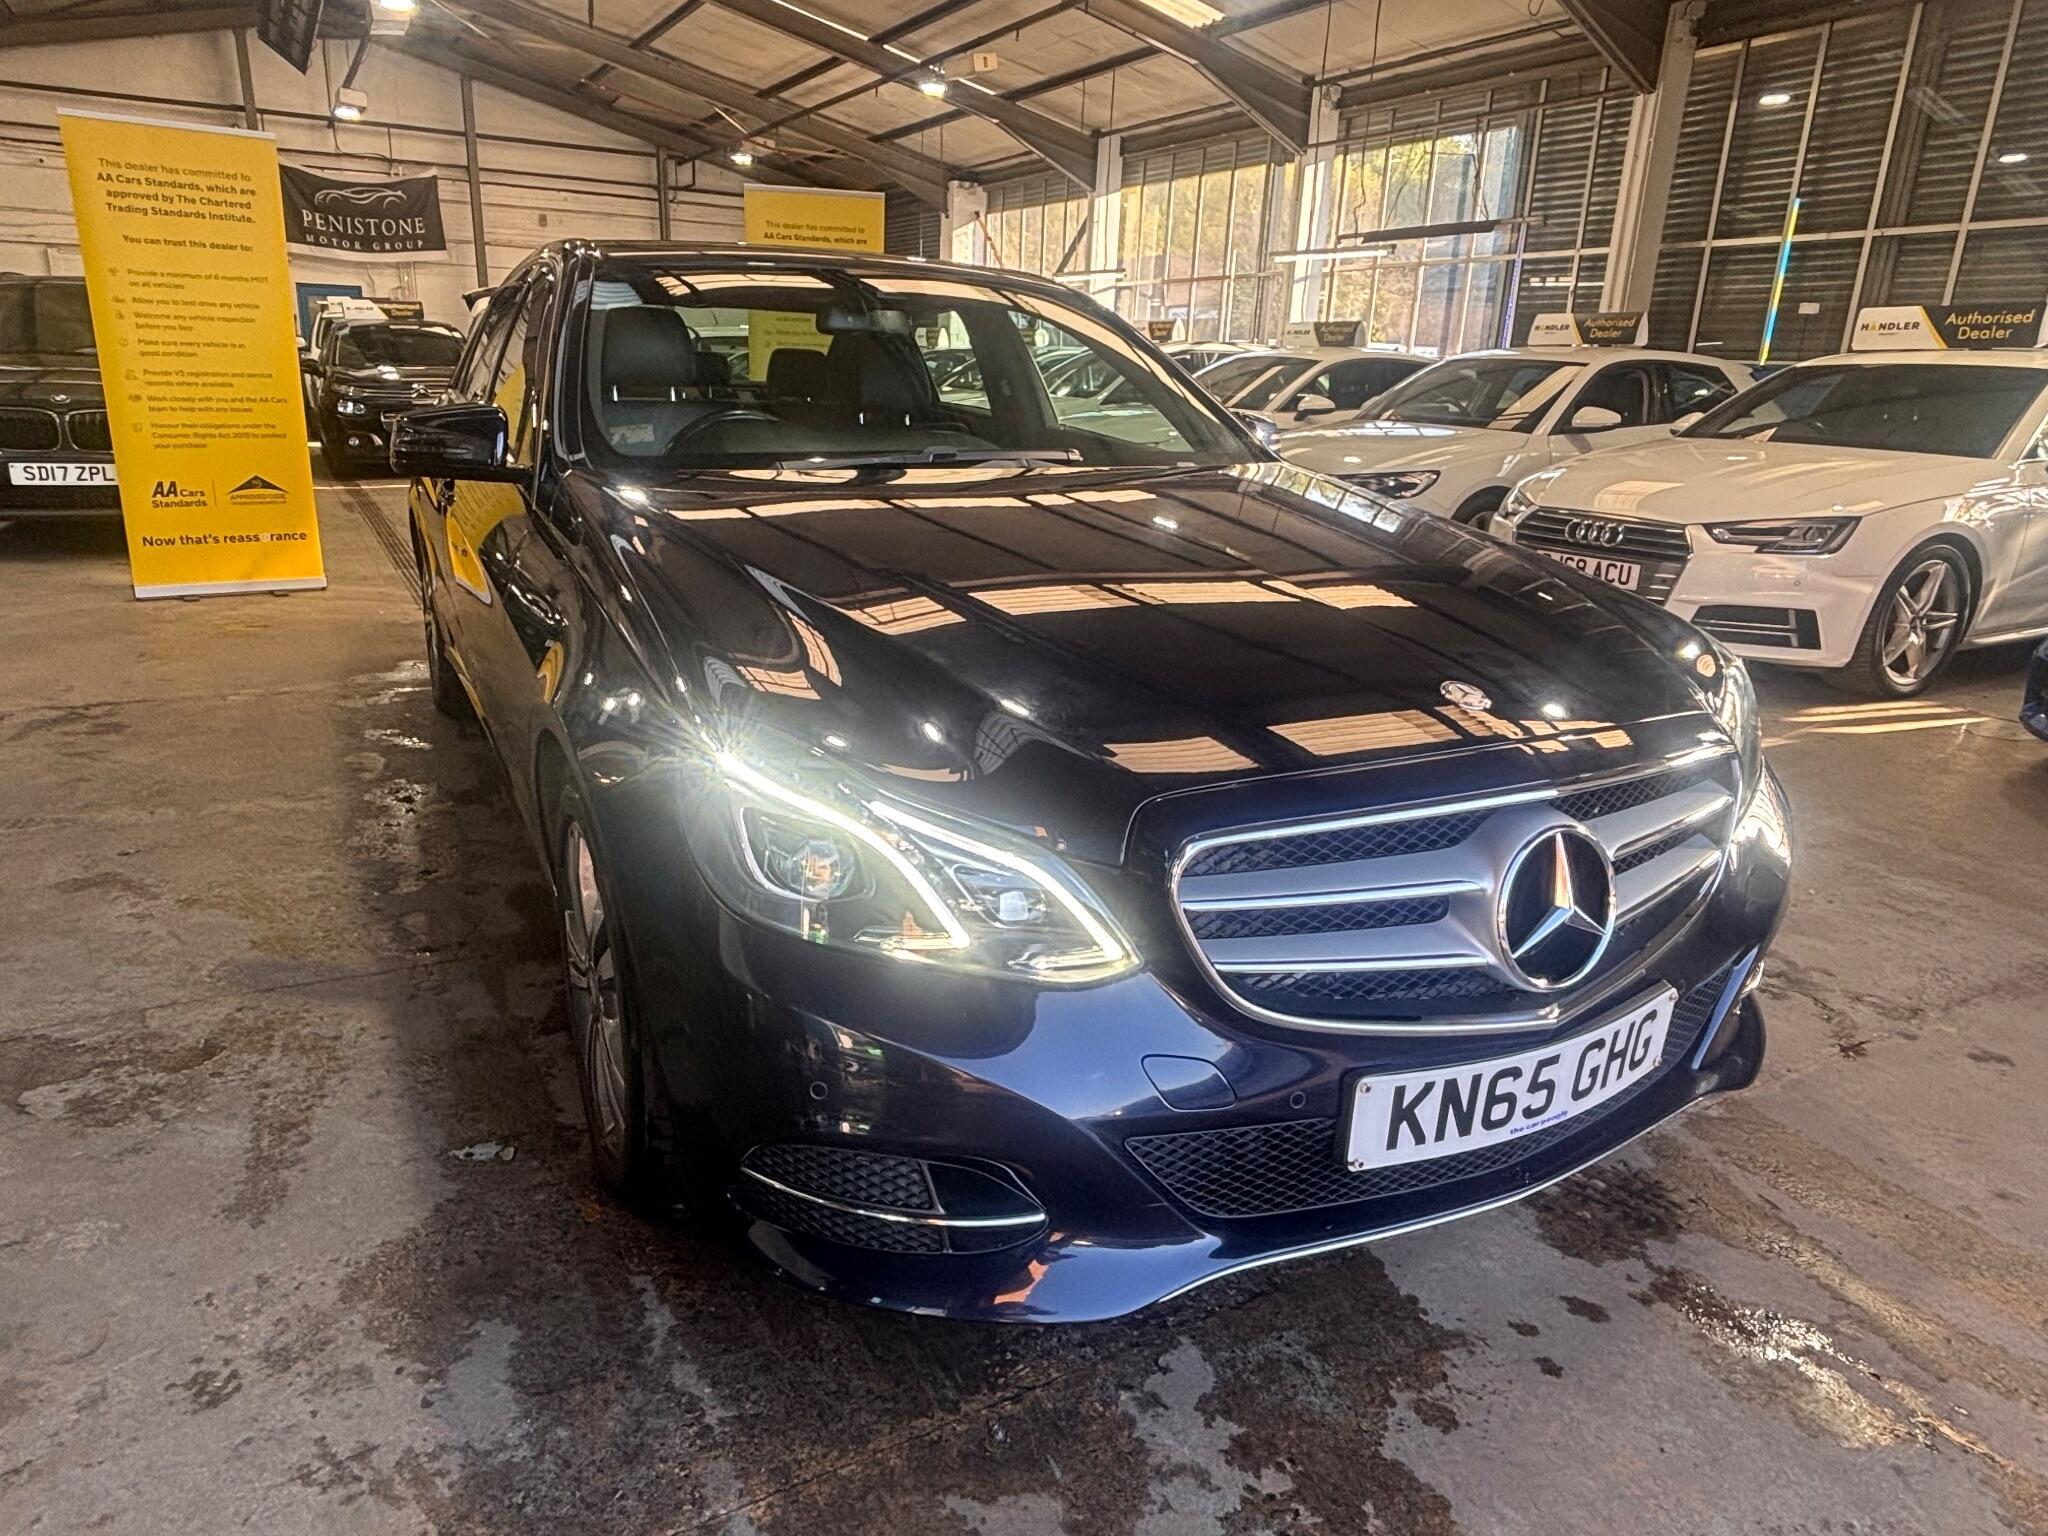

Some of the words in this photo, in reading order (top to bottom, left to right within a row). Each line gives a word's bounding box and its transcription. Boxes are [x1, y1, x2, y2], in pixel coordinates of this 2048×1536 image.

[98, 158, 122, 169] This
[125, 162, 158, 172] dealer
[161, 165, 180, 175] has
[182, 168, 237, 180] committed
[241, 173, 251, 182] to
[97, 172, 114, 183] AA
[116, 174, 142, 186] Cars
[144, 178, 204, 192] Standards,
[206, 184, 237, 195] which
[239, 188, 256, 196] are
[106, 188, 159, 202] approved
[162, 193, 174, 205] by
[176, 194, 197, 205] The
[199, 196, 252, 210] Chartered
[105, 202, 148, 216] Trading
[150, 206, 207, 220] Standards
[209, 211, 256, 223] Institute.
[302, 209, 426, 236] PENISTONE
[766, 220, 781, 229] This
[782, 222, 804, 230] dealer
[805, 223, 818, 231] has
[819, 225, 857, 234] committed
[122, 234, 141, 244] You
[143, 237, 161, 245] can
[163, 238, 187, 247] trust
[188, 239, 207, 249] this
[209, 241, 238, 251] dealer
[306, 233, 361, 250] MOTOR
[373, 239, 424, 250] GROUP
[763, 232, 774, 240] AA
[776, 233, 793, 241] Cars
[834, 236, 855, 245] which
[1584, 317, 1637, 328] Authorised
[1945, 308, 2036, 326] Authorised
[1590, 328, 1623, 338] Dealer
[1957, 326, 2013, 340] Dealer
[23, 466, 68, 481] SD17
[75, 466, 116, 482] ZPL
[152, 481, 178, 498] AA
[179, 489, 206, 498] Cars
[152, 499, 208, 509] Standards
[142, 536, 176, 547] Now
[179, 533, 220, 545] that's
[223, 531, 307, 545] reassrance
[1594, 561, 1633, 586] ACU
[1386, 1054, 1561, 1151] KN65
[1571, 1009, 1658, 1102] GHG
